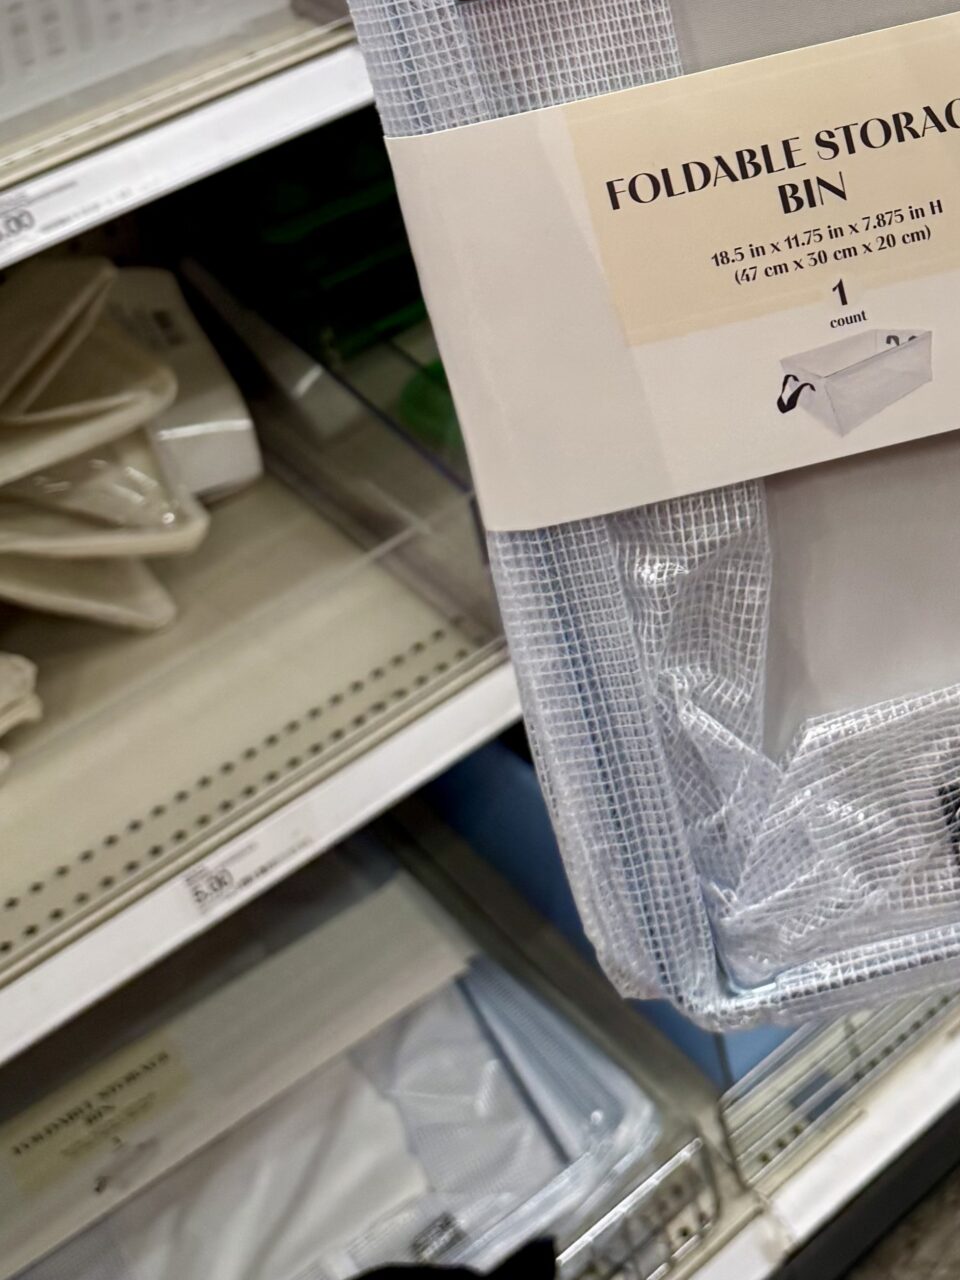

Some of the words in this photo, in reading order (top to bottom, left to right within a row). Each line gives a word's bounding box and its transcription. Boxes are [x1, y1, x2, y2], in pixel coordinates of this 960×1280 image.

[606, 136, 807, 211] FOLDABLE
[778, 171, 847, 214] BIN
[711, 246, 745, 267] 18.5
[748, 243, 766, 258] in
[770, 241, 782, 253] x
[784, 228, 823, 249] 11.75
[827, 225, 844, 239] in
[848, 223, 860, 235] x
[862, 208, 904, 231] 7.875
[908, 205, 925, 220] in
[929, 199, 943, 215] H
[735, 266, 758, 285] (47
[764, 262, 789, 277] cm
[793, 258, 804, 271] x
[807, 249, 828, 267] 30
[833, 245, 858, 261] cm
[862, 242, 873, 254] x
[876, 233, 897, 251] 20
[901, 224, 931, 245] cm)
[832, 278, 848, 306] 1
[830, 310, 867, 329] count
